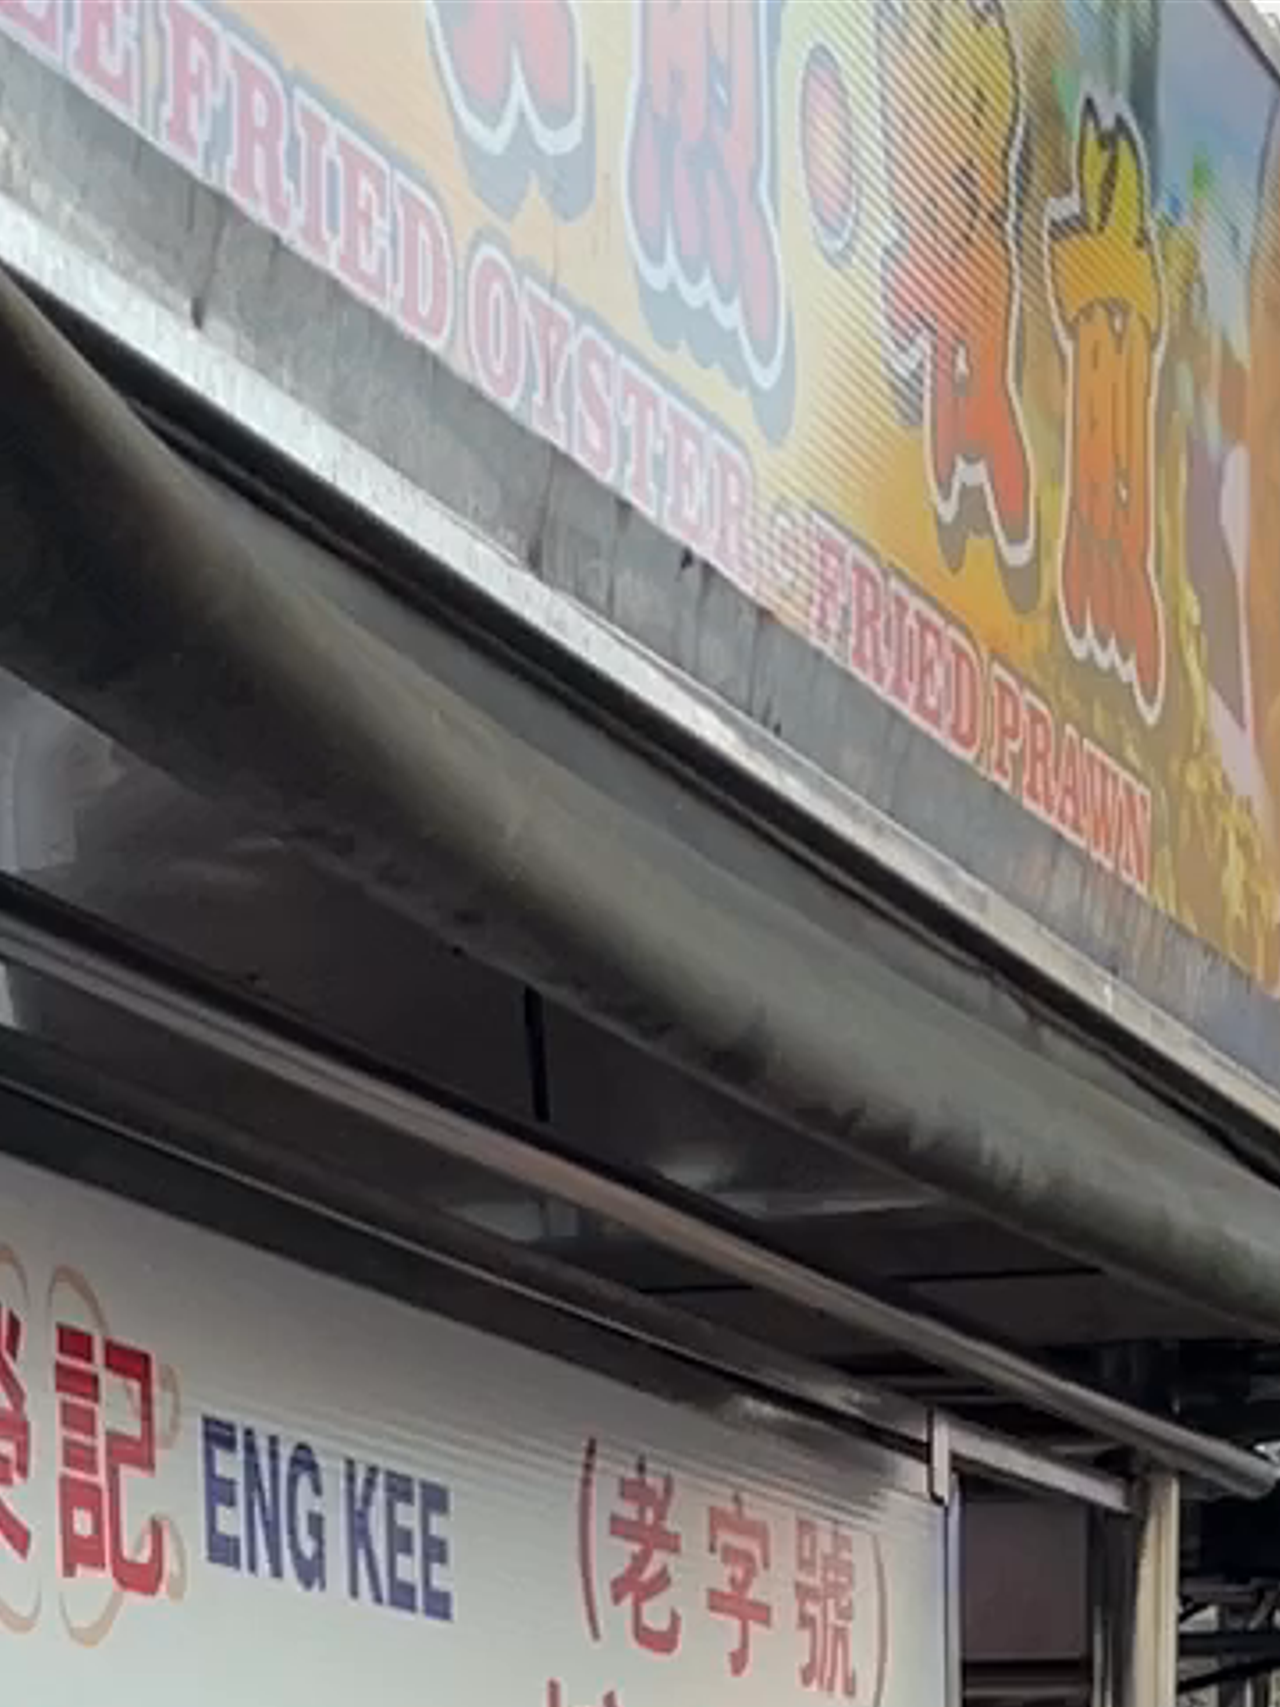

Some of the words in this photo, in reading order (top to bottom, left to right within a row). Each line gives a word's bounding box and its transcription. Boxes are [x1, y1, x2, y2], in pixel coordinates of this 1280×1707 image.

[160, 0, 453, 345] FRIED
[466, 245, 756, 600] OYSTER
[805, 510, 982, 770] FRIED
[990, 663, 1151, 900] PRAWN
[201, 1415, 326, 1593] ENG
[342, 1457, 452, 1622] KEE
